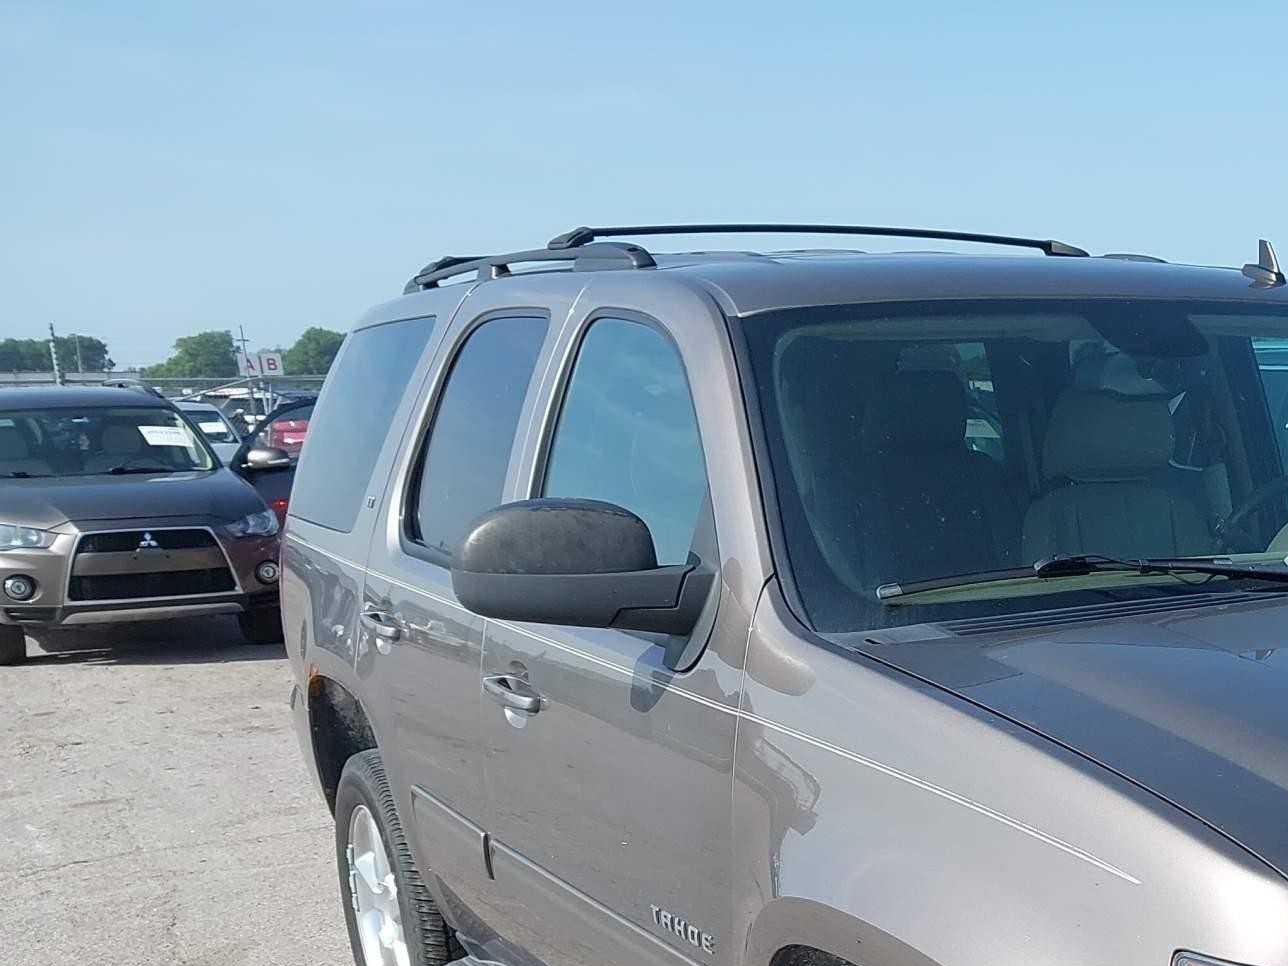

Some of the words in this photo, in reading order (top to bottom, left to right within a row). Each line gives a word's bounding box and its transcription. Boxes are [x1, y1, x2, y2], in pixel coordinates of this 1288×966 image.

[245, 358, 256, 371] A
[267, 358, 278, 370] B
[650, 904, 715, 955] TAHOE
